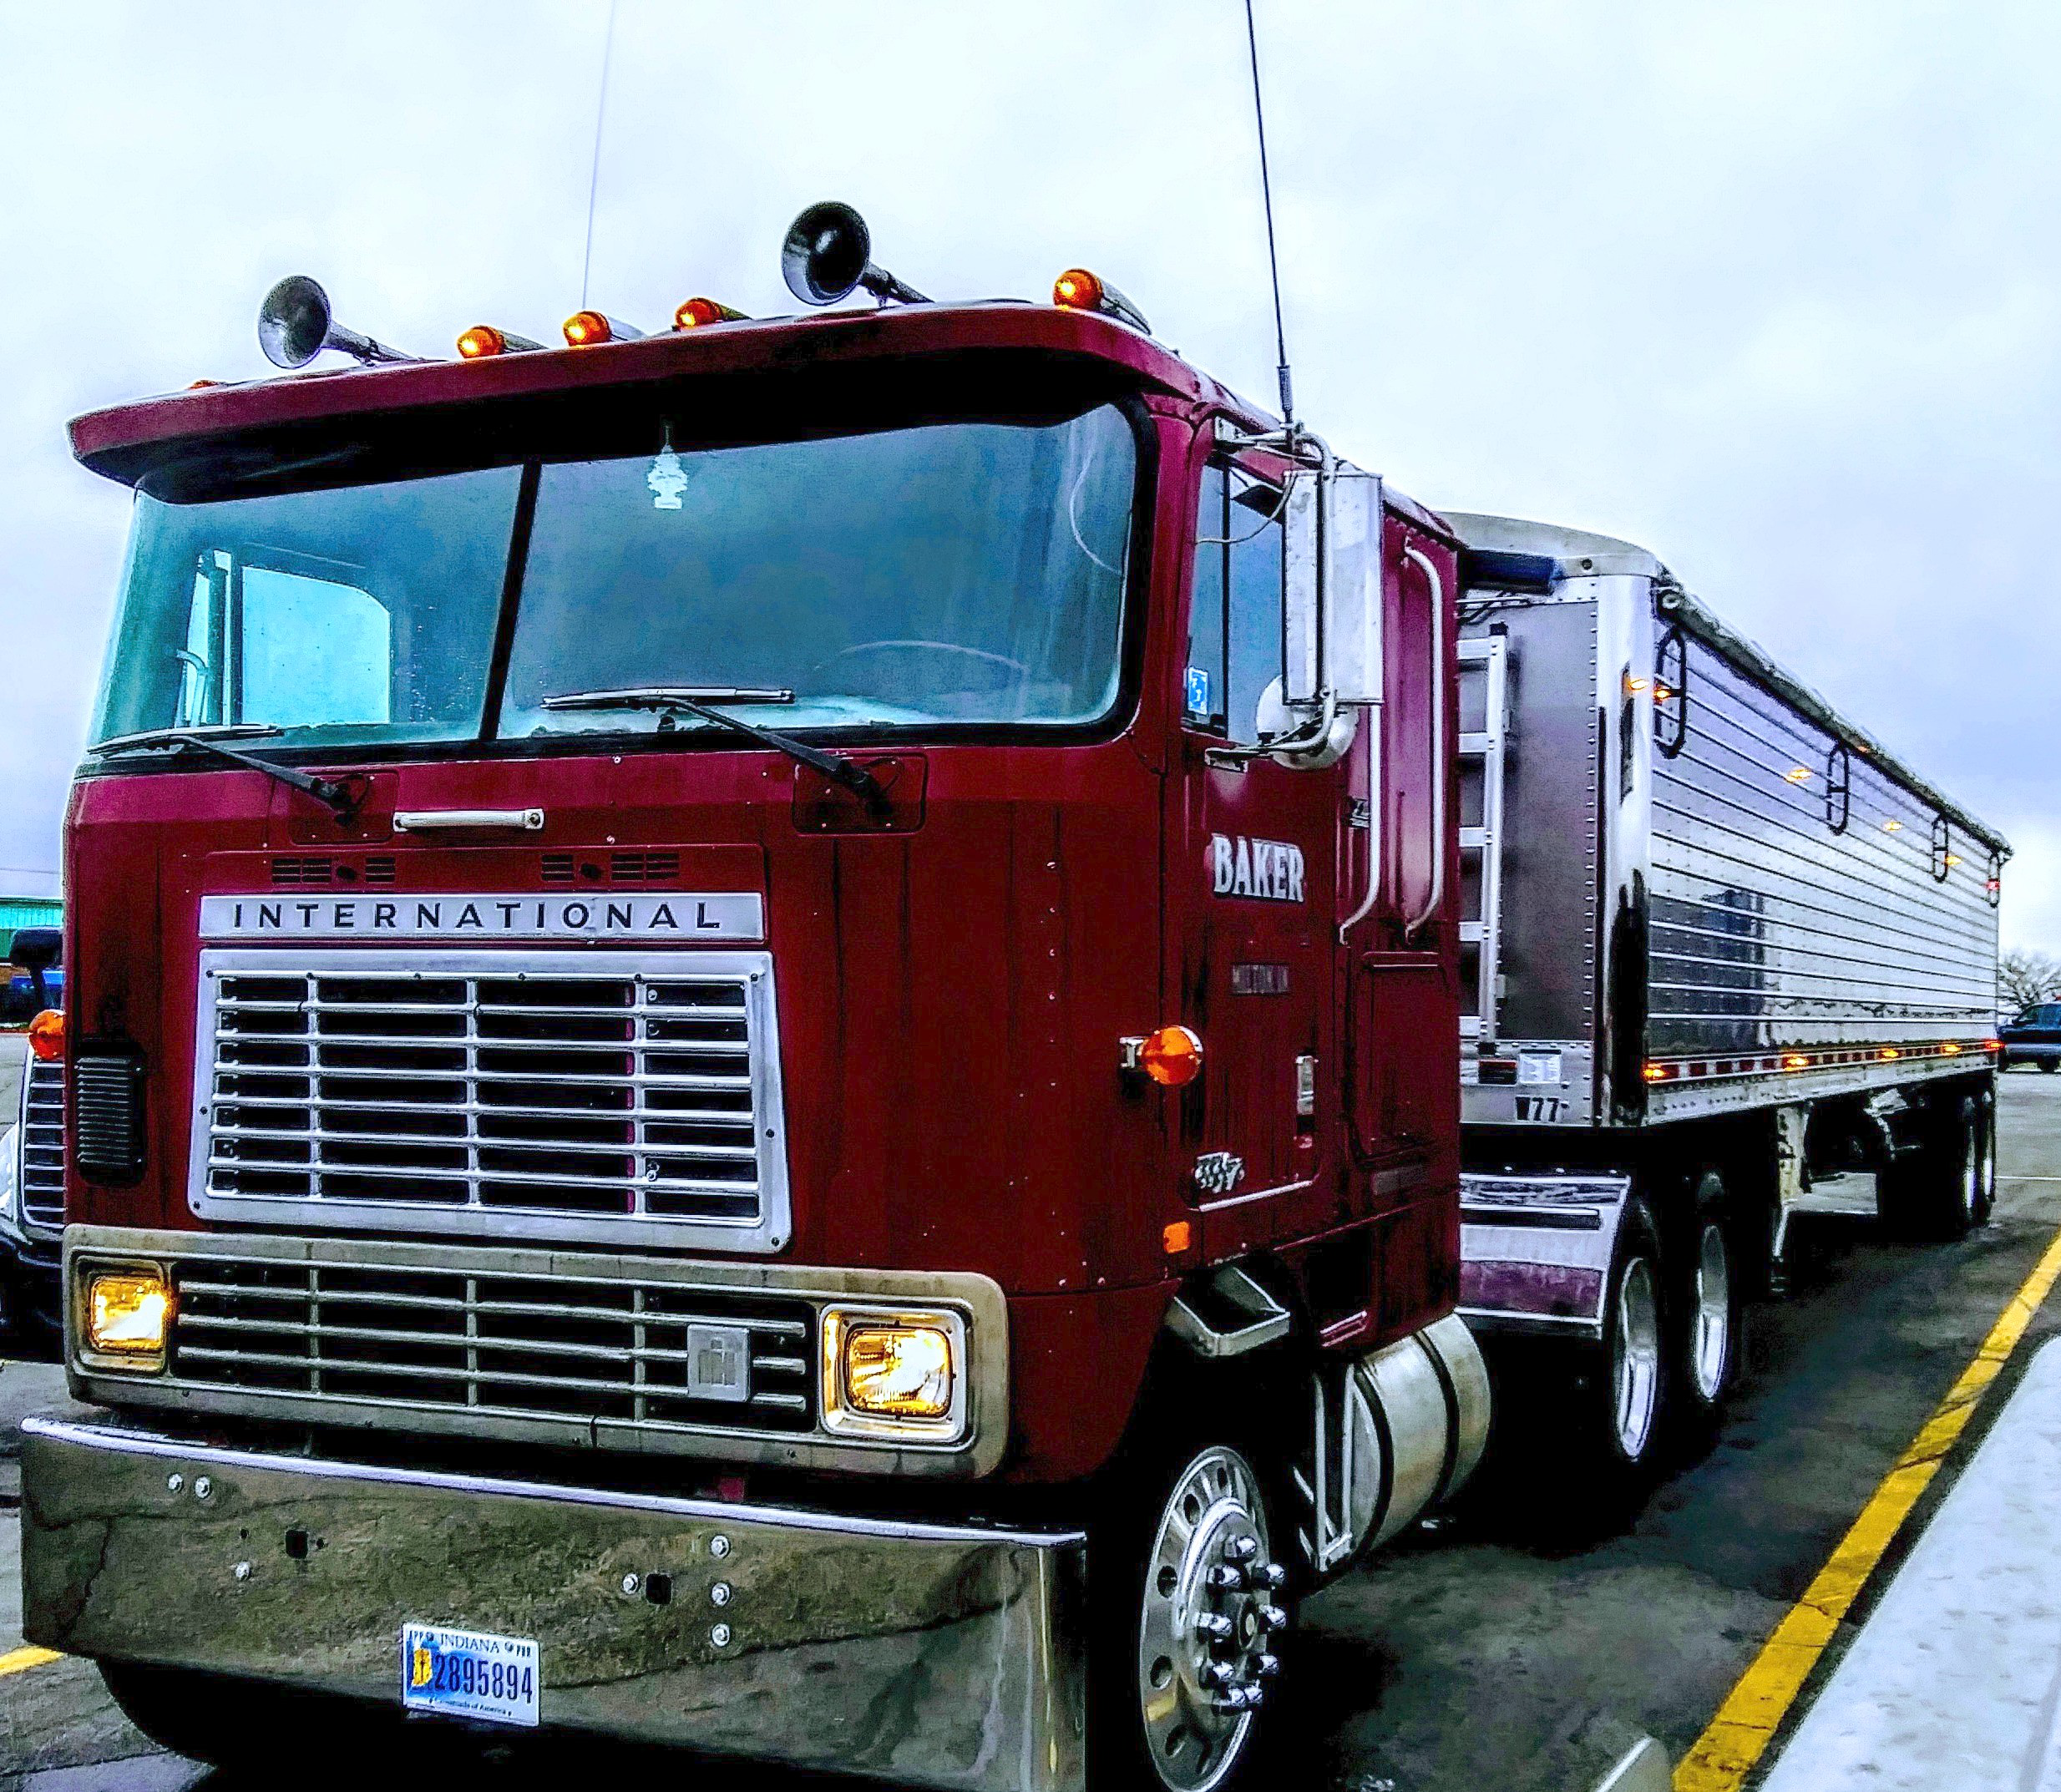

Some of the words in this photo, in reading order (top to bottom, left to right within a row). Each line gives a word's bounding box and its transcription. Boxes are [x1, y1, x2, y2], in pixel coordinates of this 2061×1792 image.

[1212, 833, 1304, 903] BAKER
[232, 901, 720, 931] INTERNATIONAL
[441, 1633, 500, 1654] INDIANA
[433, 1653, 533, 1704] 2895894
